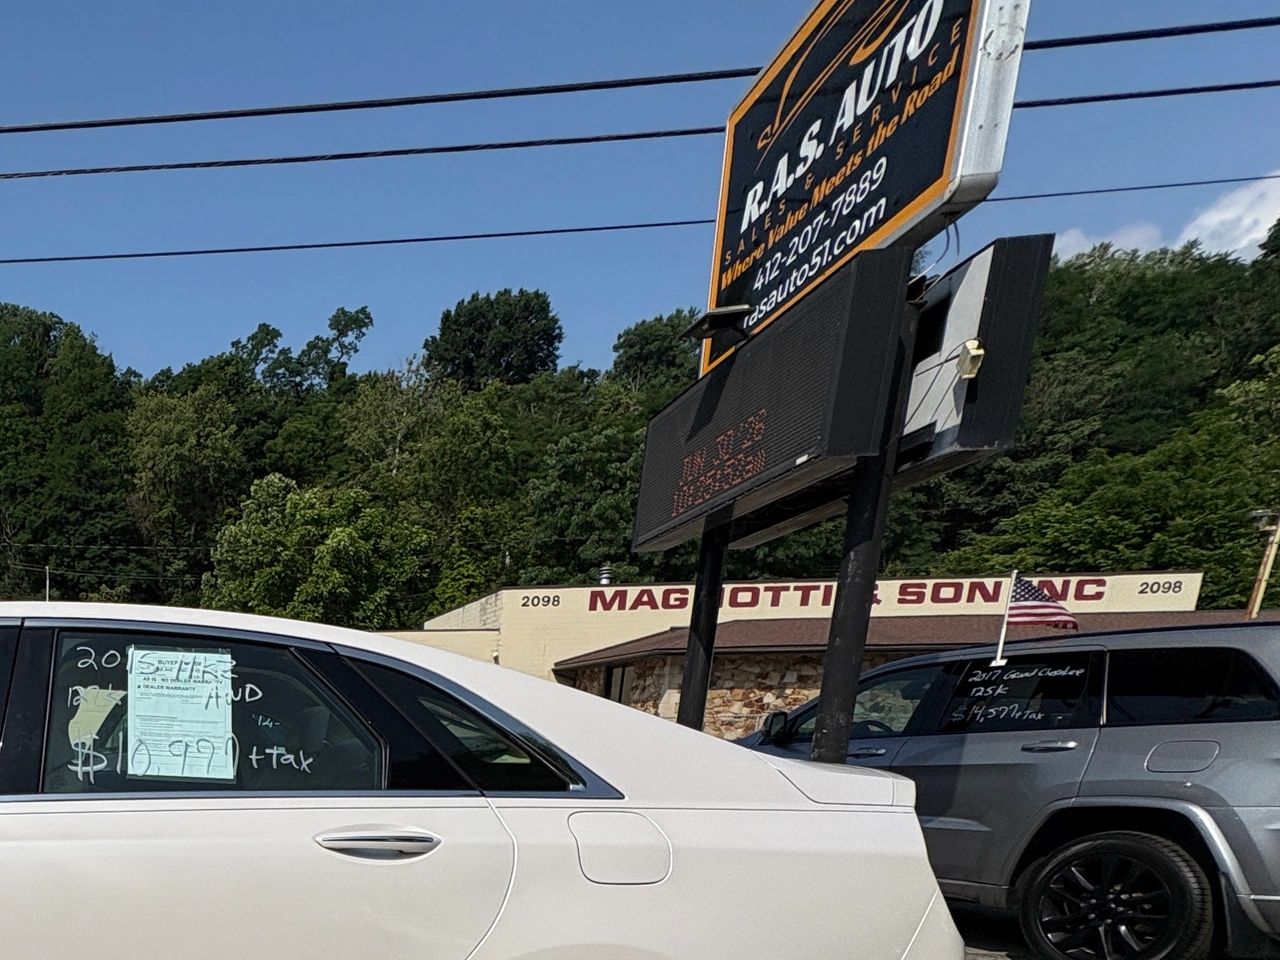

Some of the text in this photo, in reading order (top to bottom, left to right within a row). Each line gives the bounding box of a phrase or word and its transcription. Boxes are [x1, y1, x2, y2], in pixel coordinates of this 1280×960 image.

[721, 43, 961, 291] Where Value Meets the Road
[724, 198, 787, 266] SALES
[835, 17, 964, 161] SERVICE
[740, 0, 945, 234] R.A.S. AUTO
[744, 197, 888, 329] rasauto51.com
[753, 156, 888, 293] 412-207-7889
[521, 595, 561, 607] 2098
[588, 584, 834, 612] MAGOTTI
[1138, 580, 1183, 595] 2098
[968, 669, 1002, 682] 2017
[1003, 667, 1039, 680] Grand
